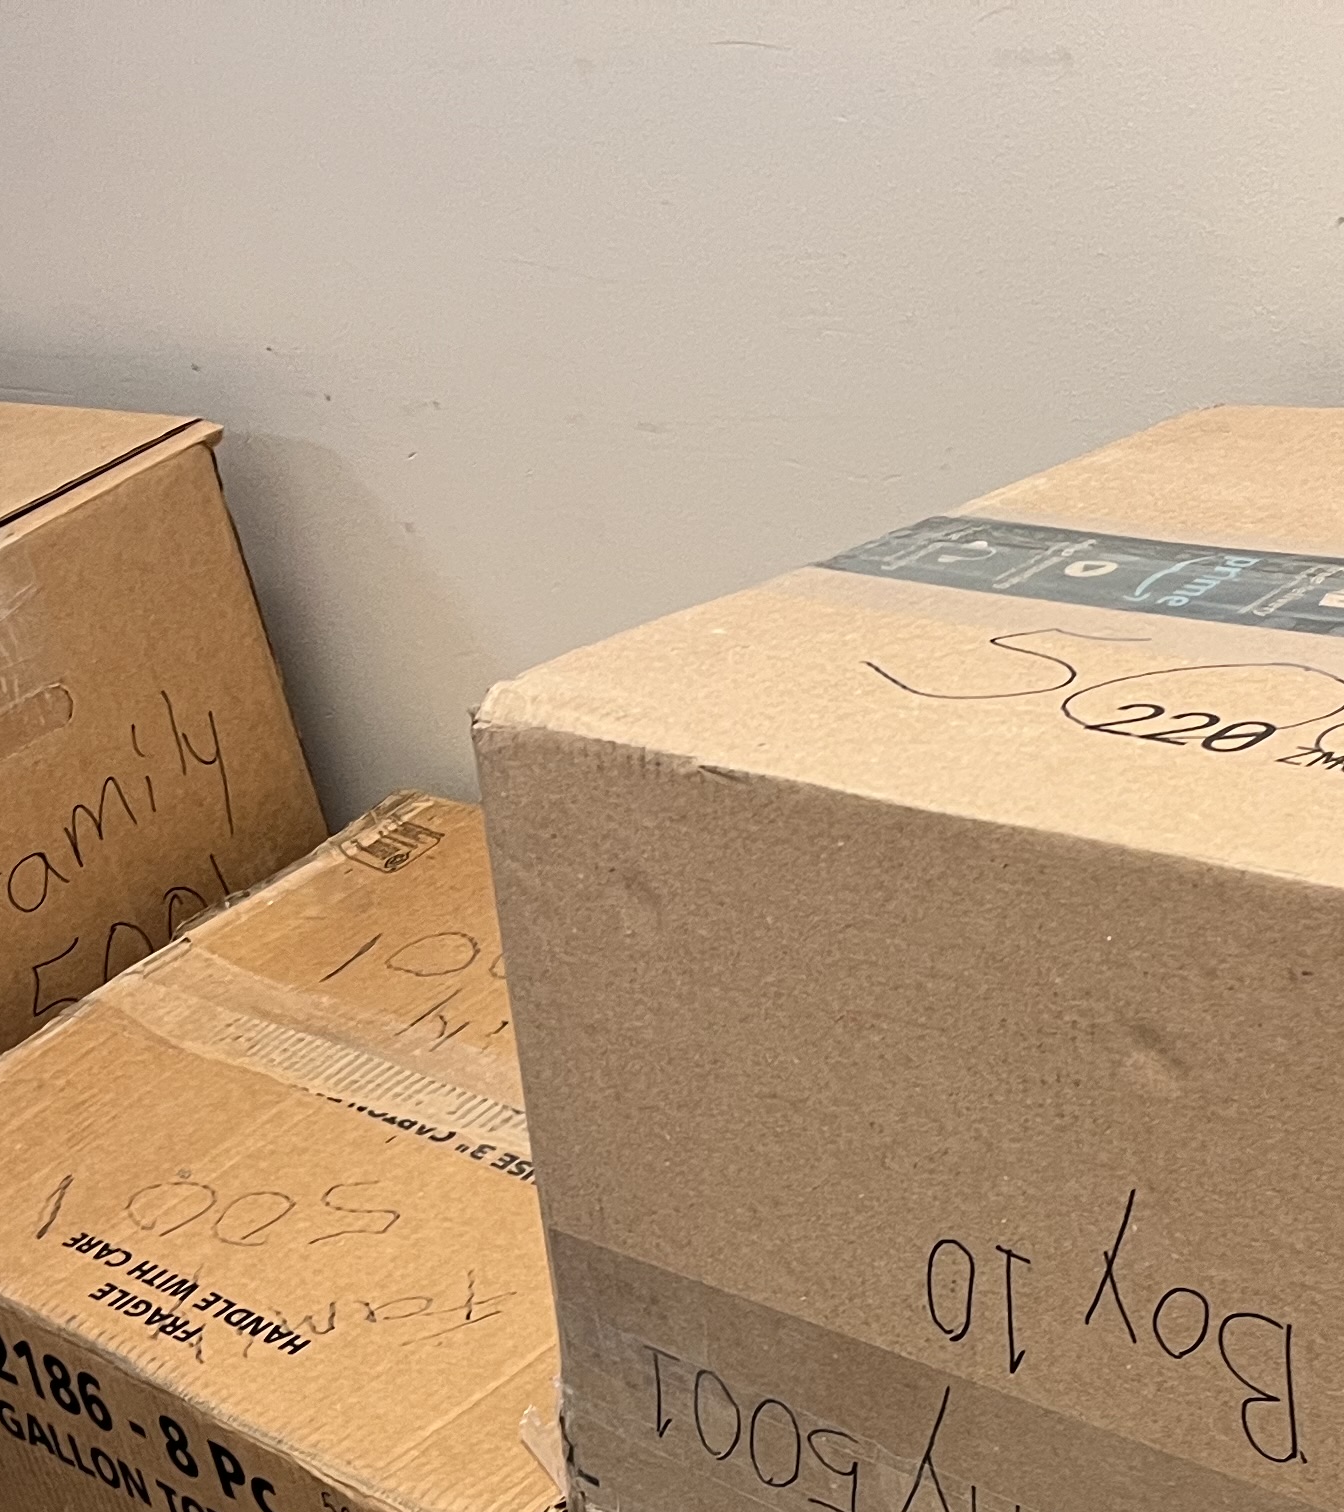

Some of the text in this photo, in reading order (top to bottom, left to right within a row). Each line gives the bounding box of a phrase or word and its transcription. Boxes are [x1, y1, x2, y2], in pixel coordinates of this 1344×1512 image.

[1083, 703, 1277, 753] 220
[61, 1232, 311, 1357] HANDLE WITH CARE
[88, 1282, 204, 1347] FRAGILE
[927, 1188, 1308, 1463] Boy 10
[158, 1414, 201, 1478] 8
